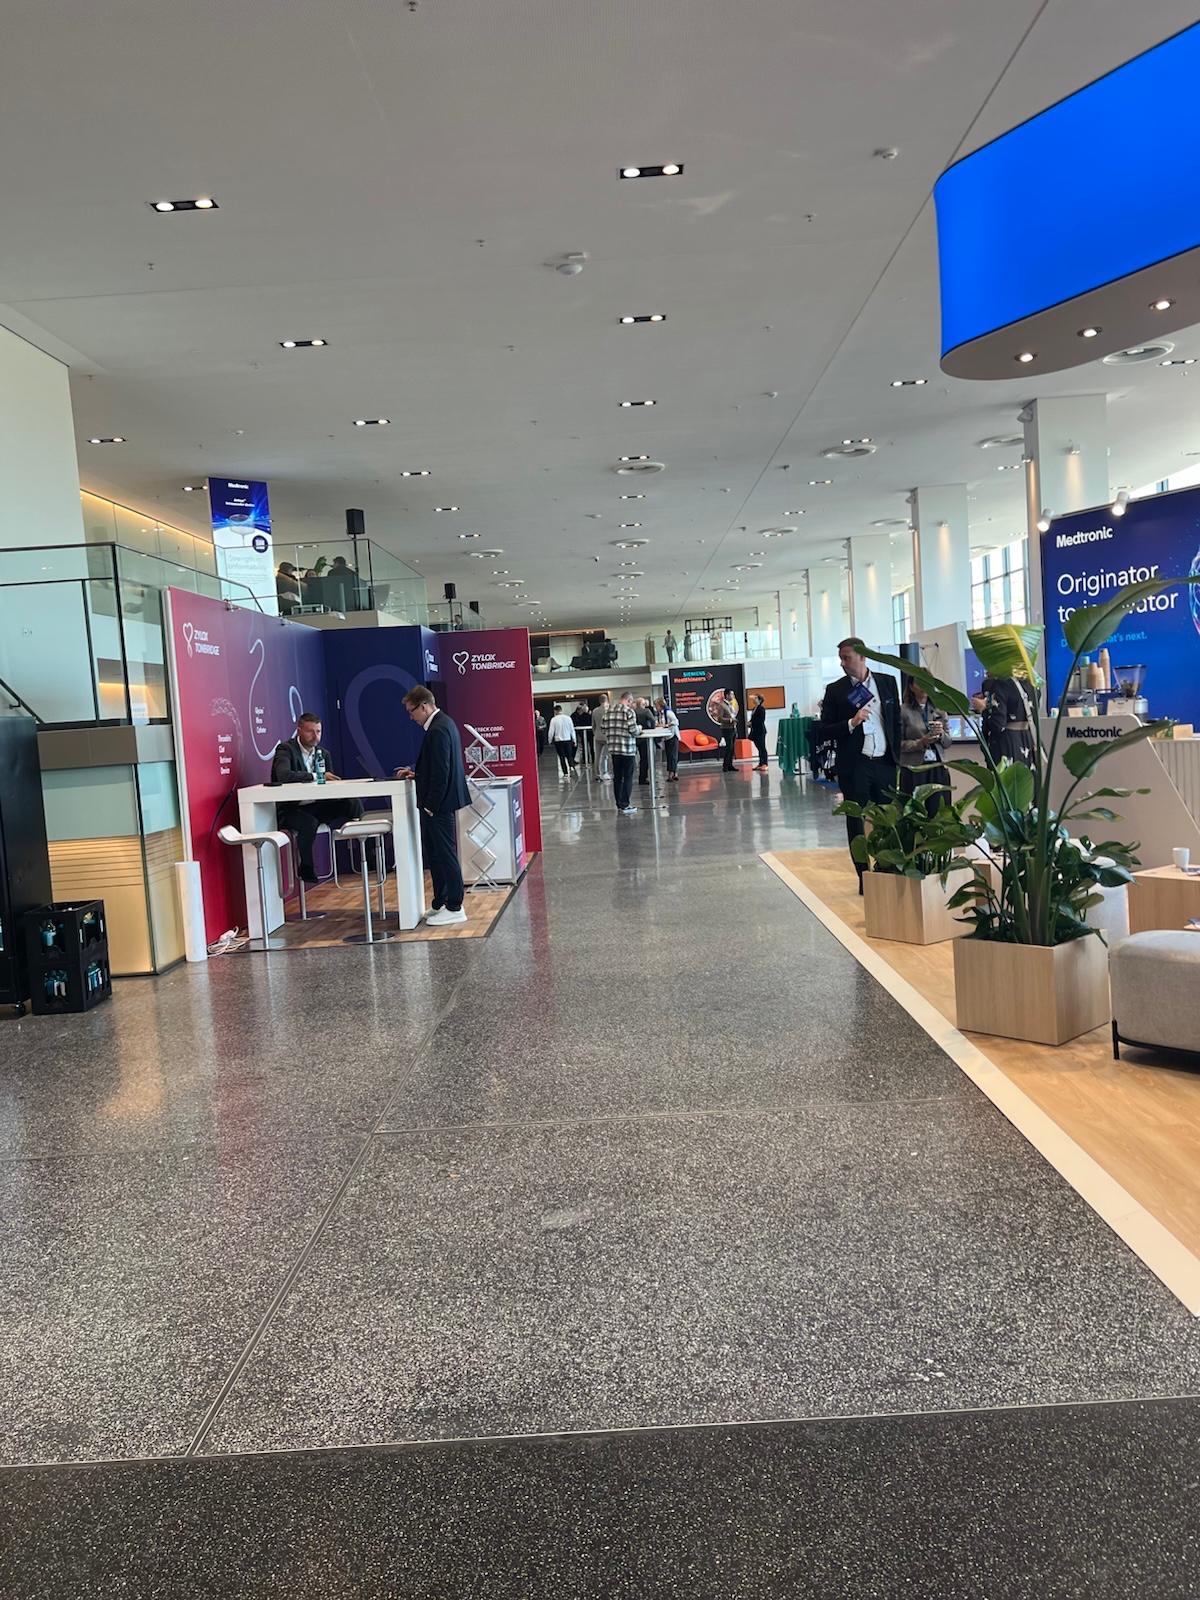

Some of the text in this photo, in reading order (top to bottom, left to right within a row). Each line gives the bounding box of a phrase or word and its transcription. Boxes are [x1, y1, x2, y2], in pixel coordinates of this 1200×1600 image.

[1056, 526, 1113, 548] Medtronic
[1057, 565, 1159, 596] Originator
[471, 653, 496, 662] ZYLOX
[471, 661, 516, 671] TONBRIDGE
[1066, 726, 1122, 738] Medtronic
